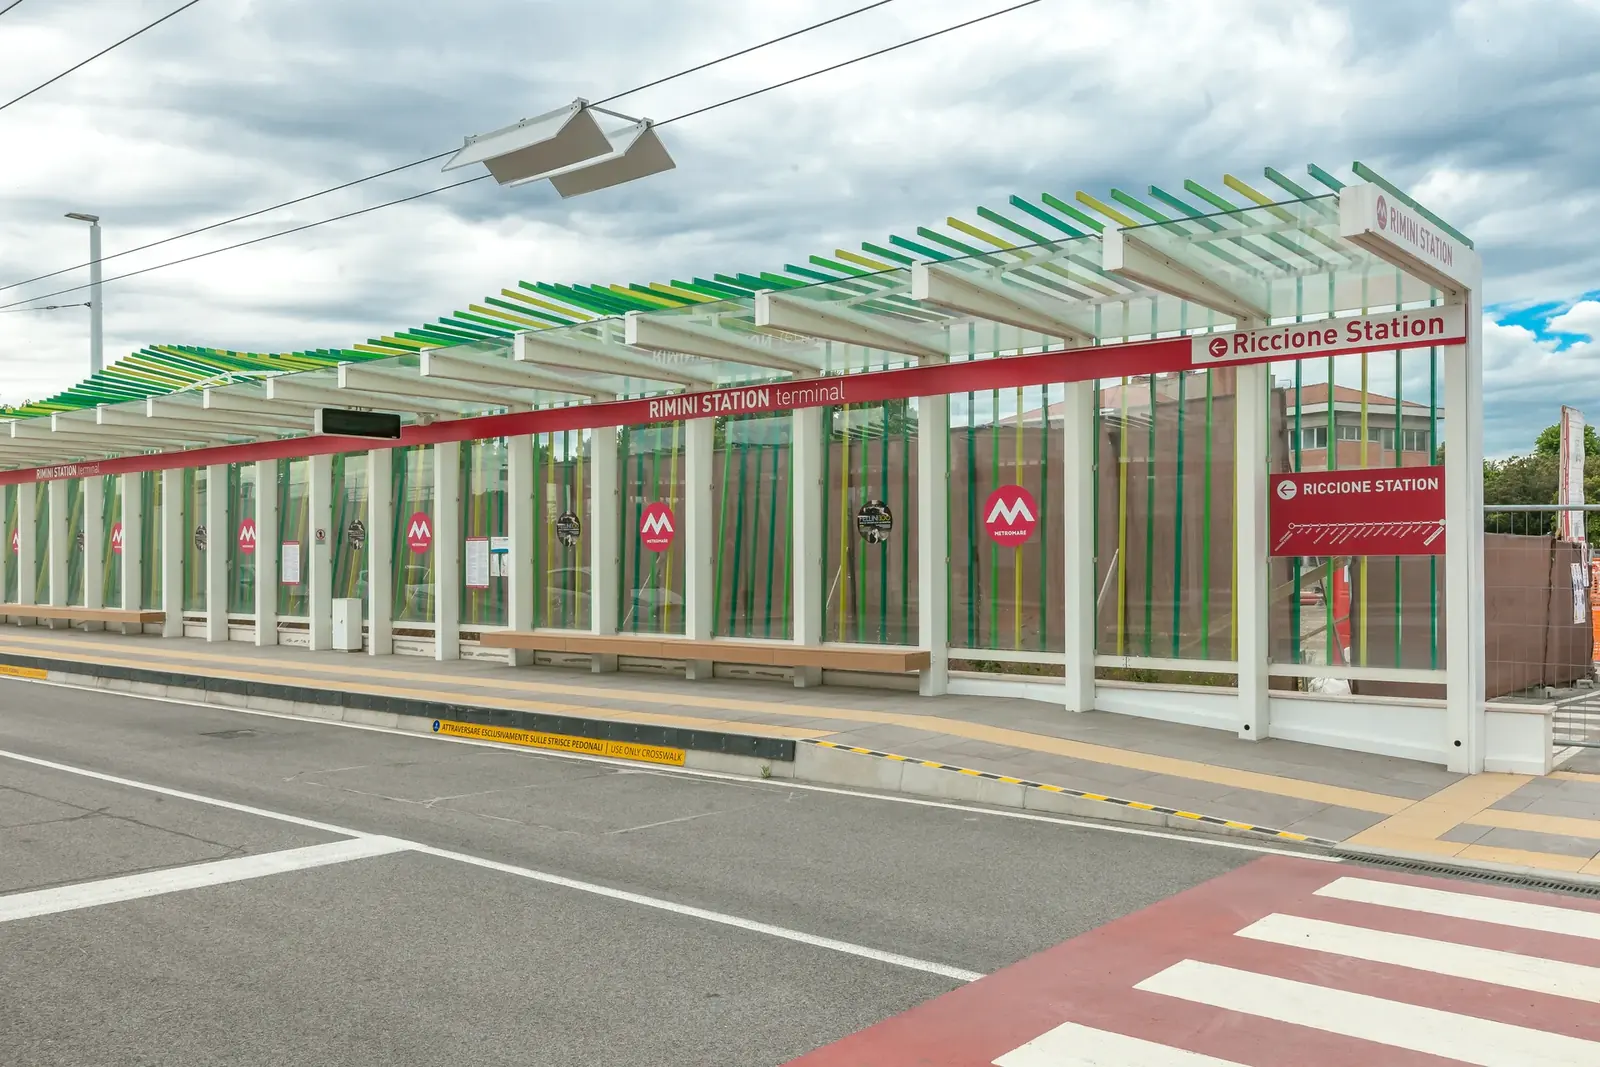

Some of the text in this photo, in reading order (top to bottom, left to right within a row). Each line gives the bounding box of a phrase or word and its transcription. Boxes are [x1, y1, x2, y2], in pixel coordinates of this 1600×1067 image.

[1390, 206, 1453, 267] RIMINI STATION
[1233, 315, 1444, 354] Riccione Station
[650, 380, 845, 419] RIMINI STATION terminal
[36, 467, 54, 479] RIMINI
[54, 464, 77, 478] STATION
[1303, 477, 1439, 495] RICCIONE STATION
[442, 723, 683, 762] ATTRAVERSARE ESCLUSIVAMENTE SULLE STRISCE PEDONALI USE ONLY CROSSWALK
